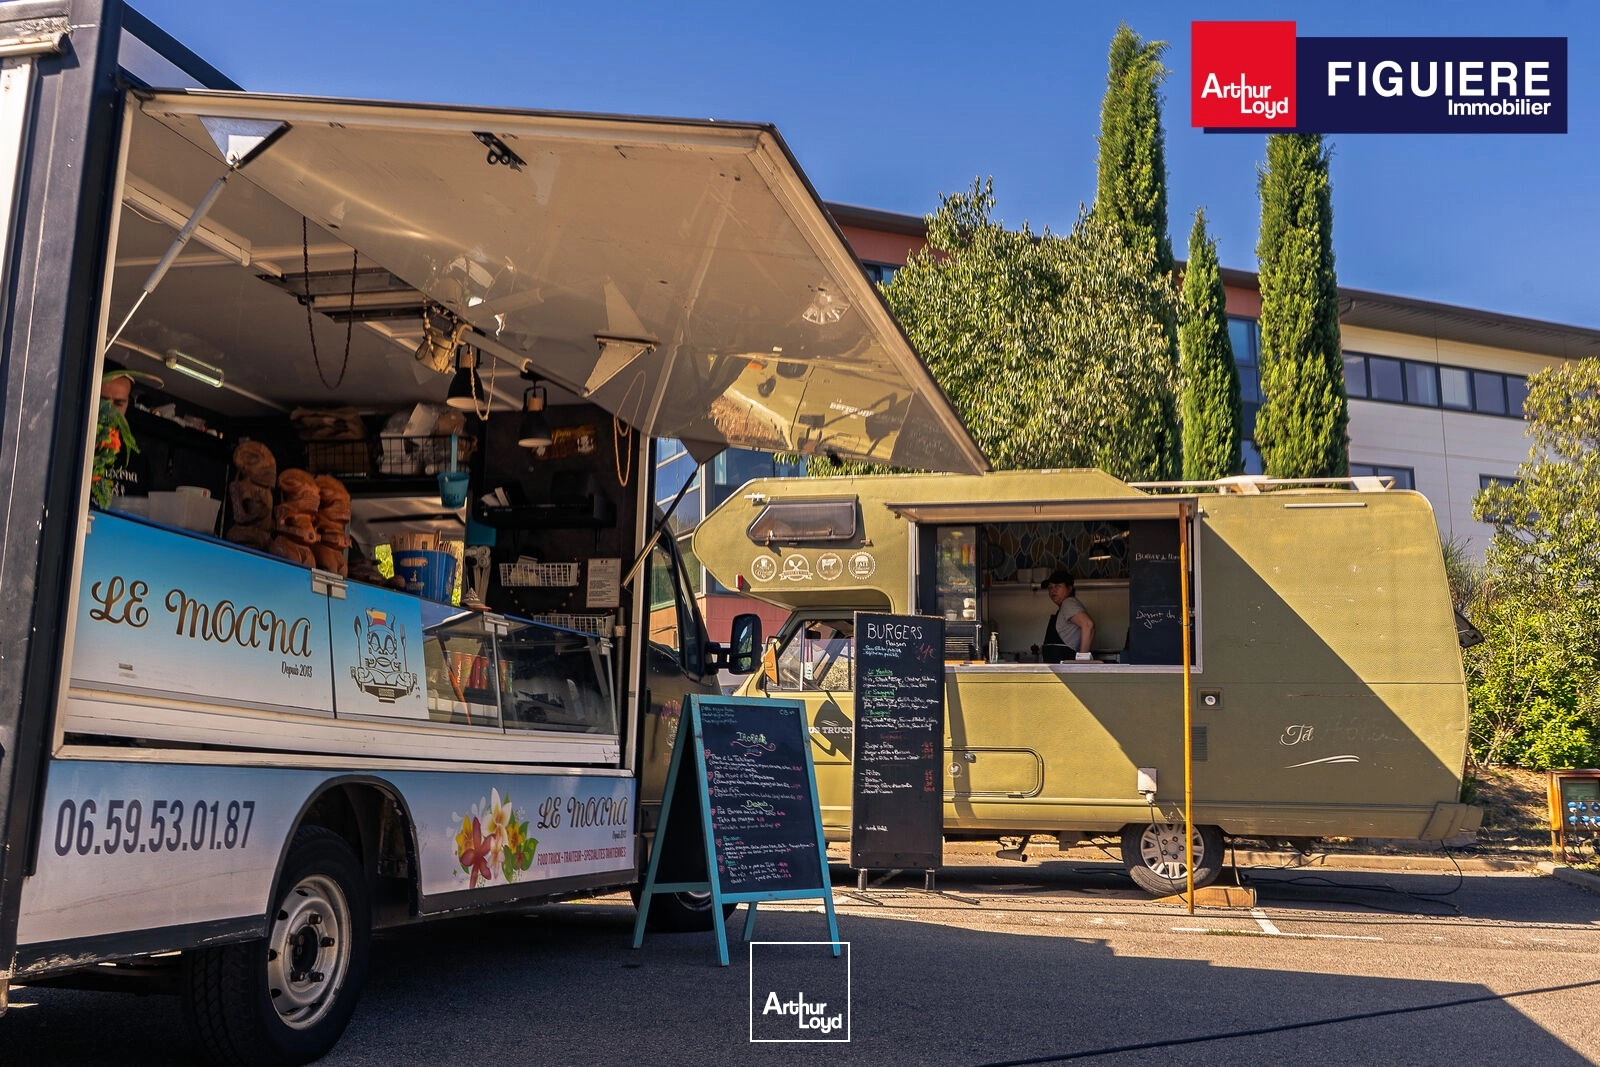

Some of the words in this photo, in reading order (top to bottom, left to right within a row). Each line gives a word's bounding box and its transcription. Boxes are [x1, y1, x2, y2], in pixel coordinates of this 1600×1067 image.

[89, 575, 149, 629] LE
[165, 588, 313, 658] MOANA
[868, 622, 922, 640] BURGERS
[281, 661, 299, 678] Depuis
[300, 664, 312, 678] 2013
[54, 798, 256, 857] 06.59.53.01.87
[537, 796, 562, 830] LE
[566, 796, 628, 828] MOANA
